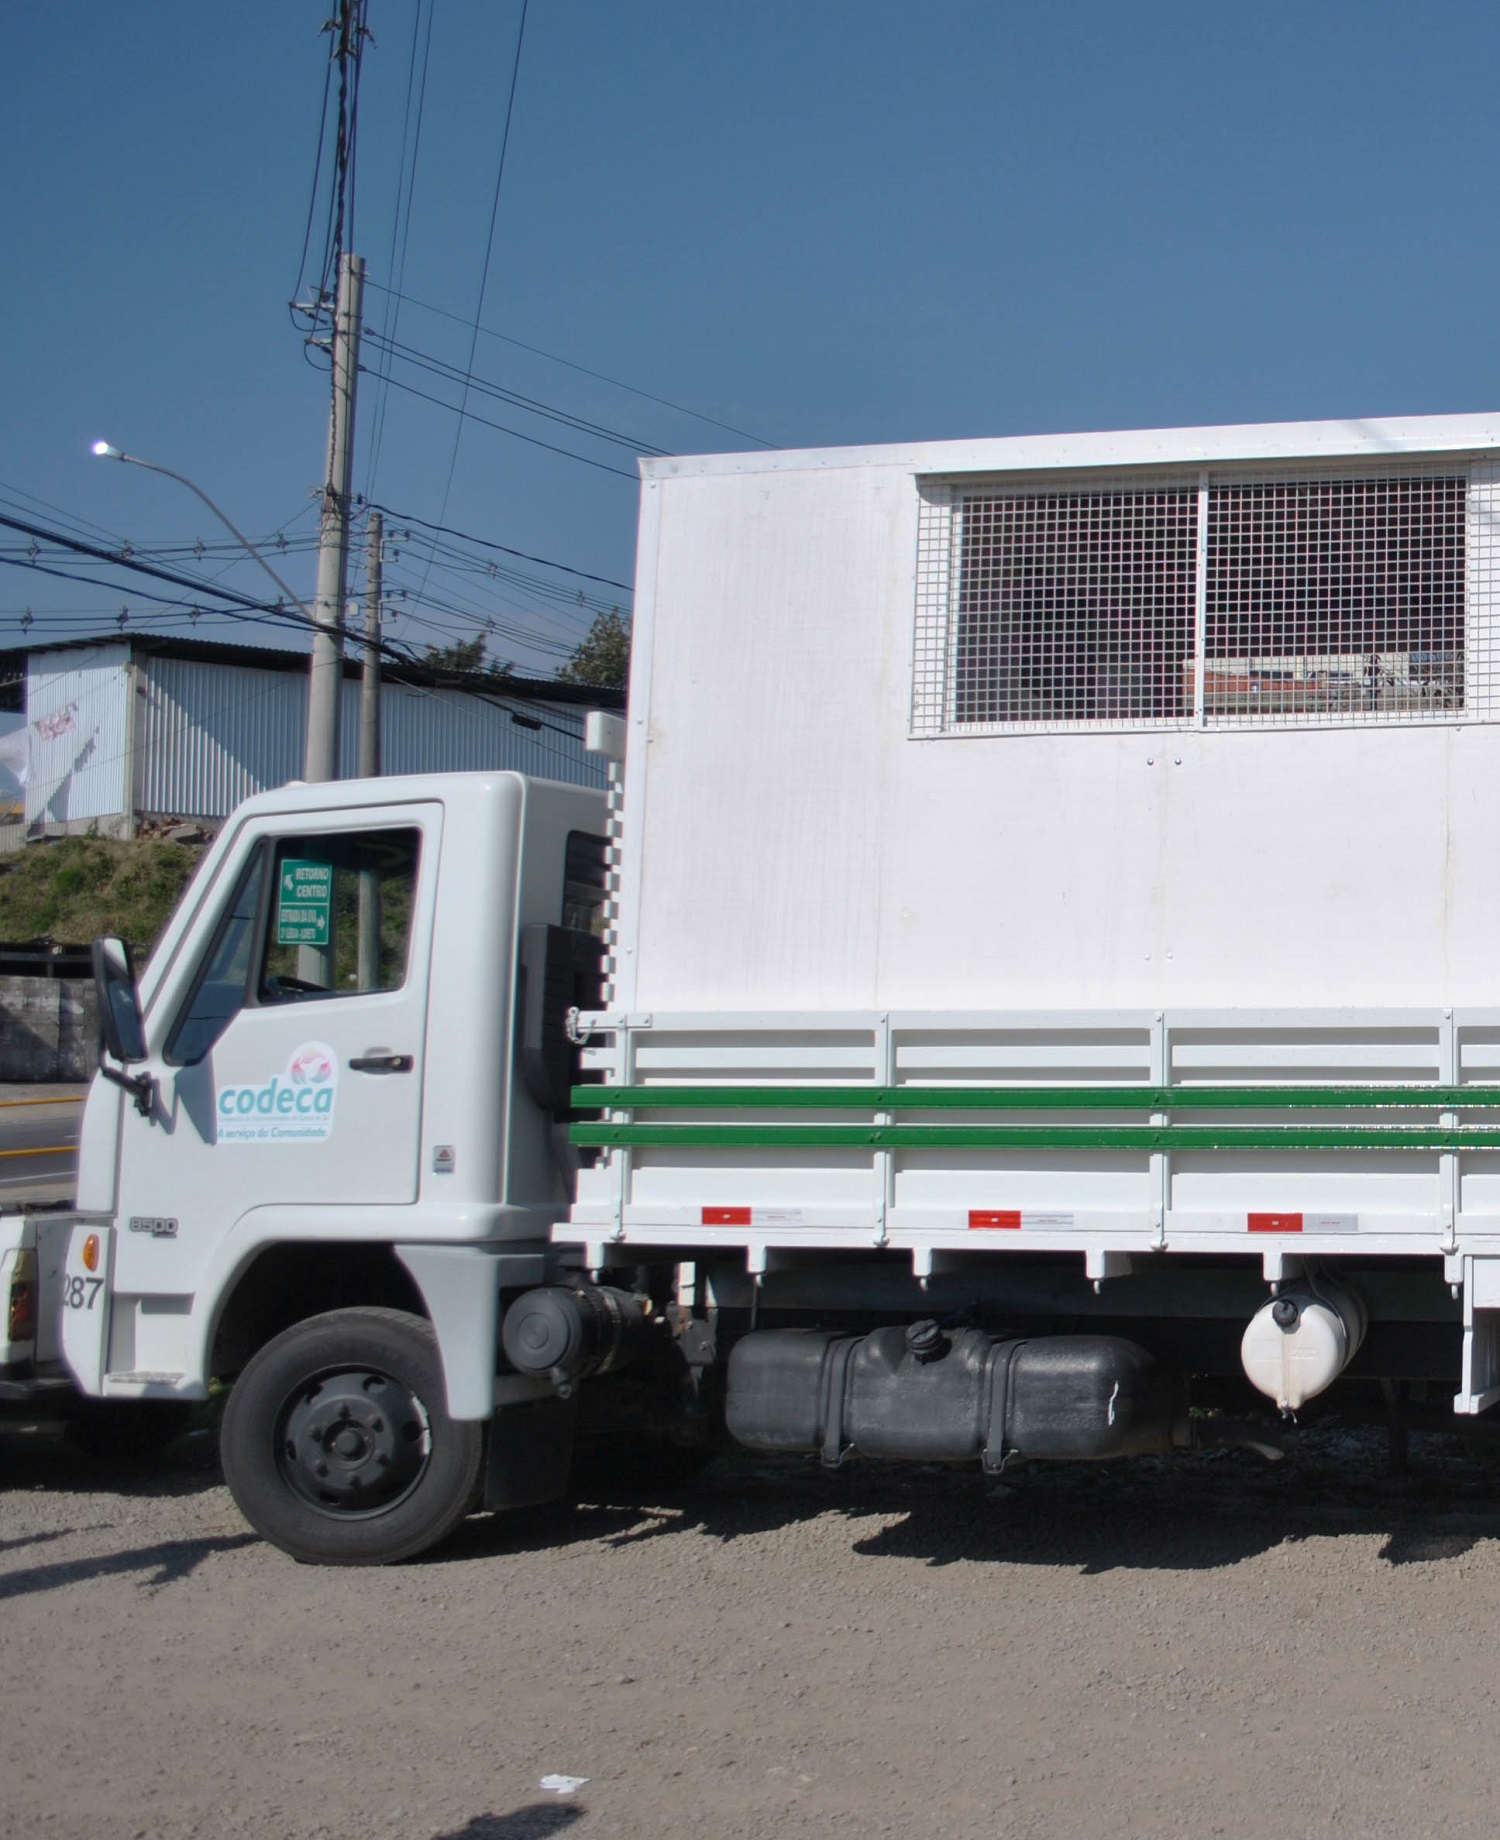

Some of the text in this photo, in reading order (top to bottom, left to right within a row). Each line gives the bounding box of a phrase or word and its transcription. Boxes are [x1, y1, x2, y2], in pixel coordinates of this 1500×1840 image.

[295, 867, 329, 880] RETORNO
[296, 885, 327, 898] CENTRO
[218, 1077, 333, 1114] codeca
[130, 1217, 179, 1233] 8500
